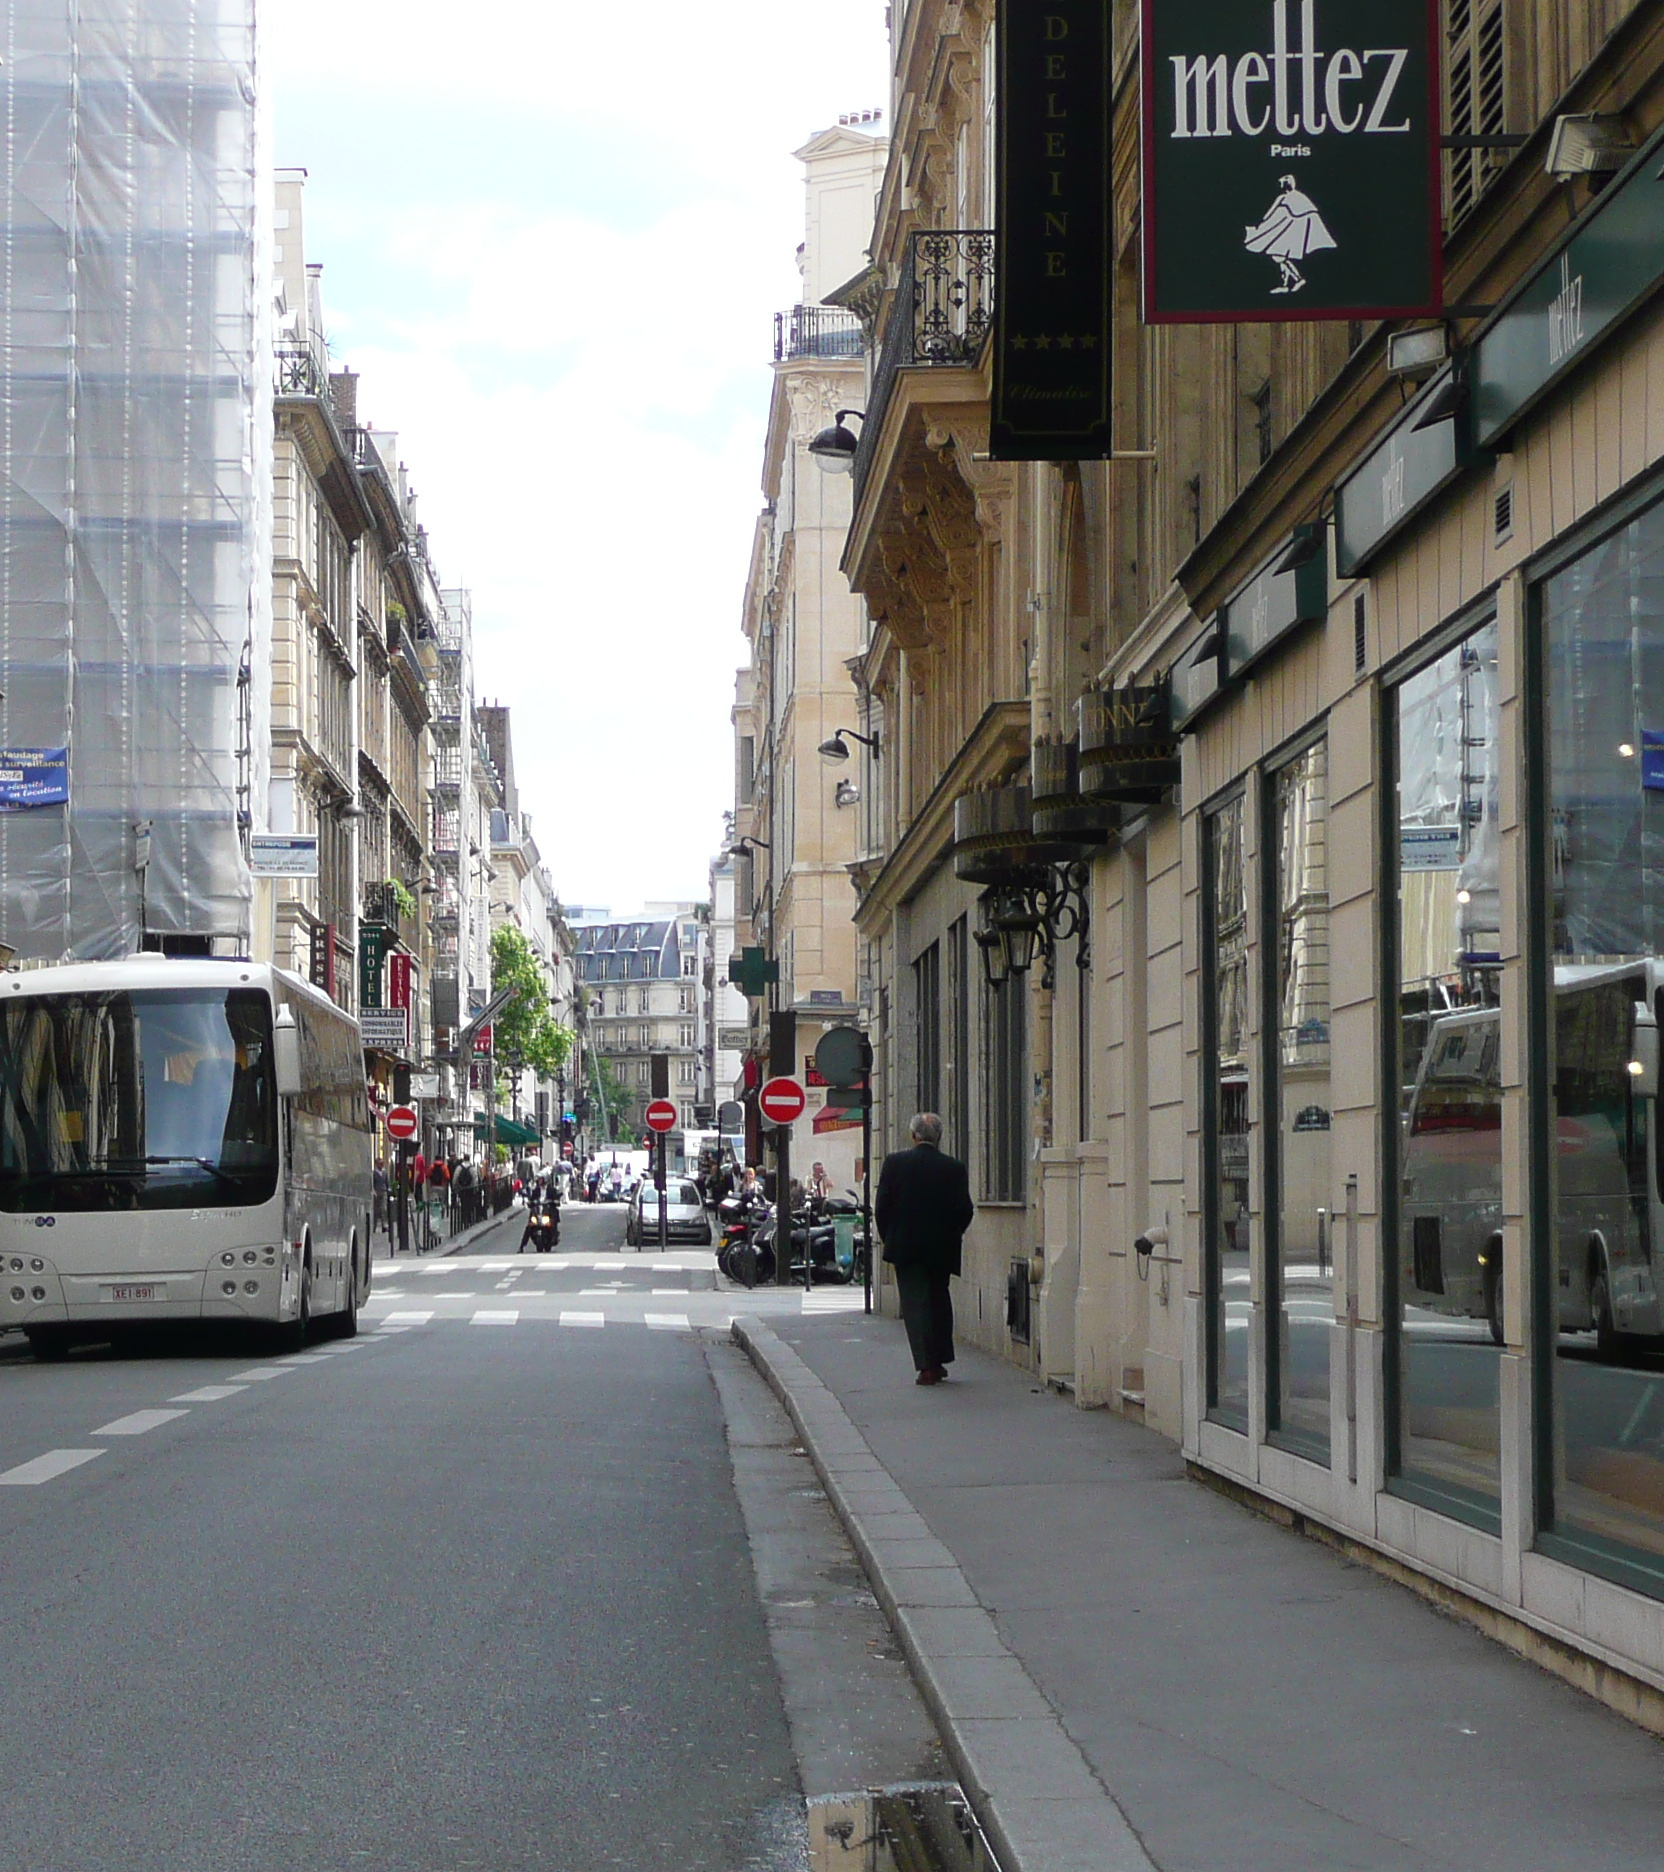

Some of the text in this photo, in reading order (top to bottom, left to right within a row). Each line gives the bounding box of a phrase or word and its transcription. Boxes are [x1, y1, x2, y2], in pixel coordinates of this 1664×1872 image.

[1169, 0, 1410, 137] mettez
[1044, 0, 1069, 277] DELEINE
[1270, 144, 1311, 157] Paris
[1548, 250, 1584, 366] mettez
[367, 945, 375, 1005] HOTEL
